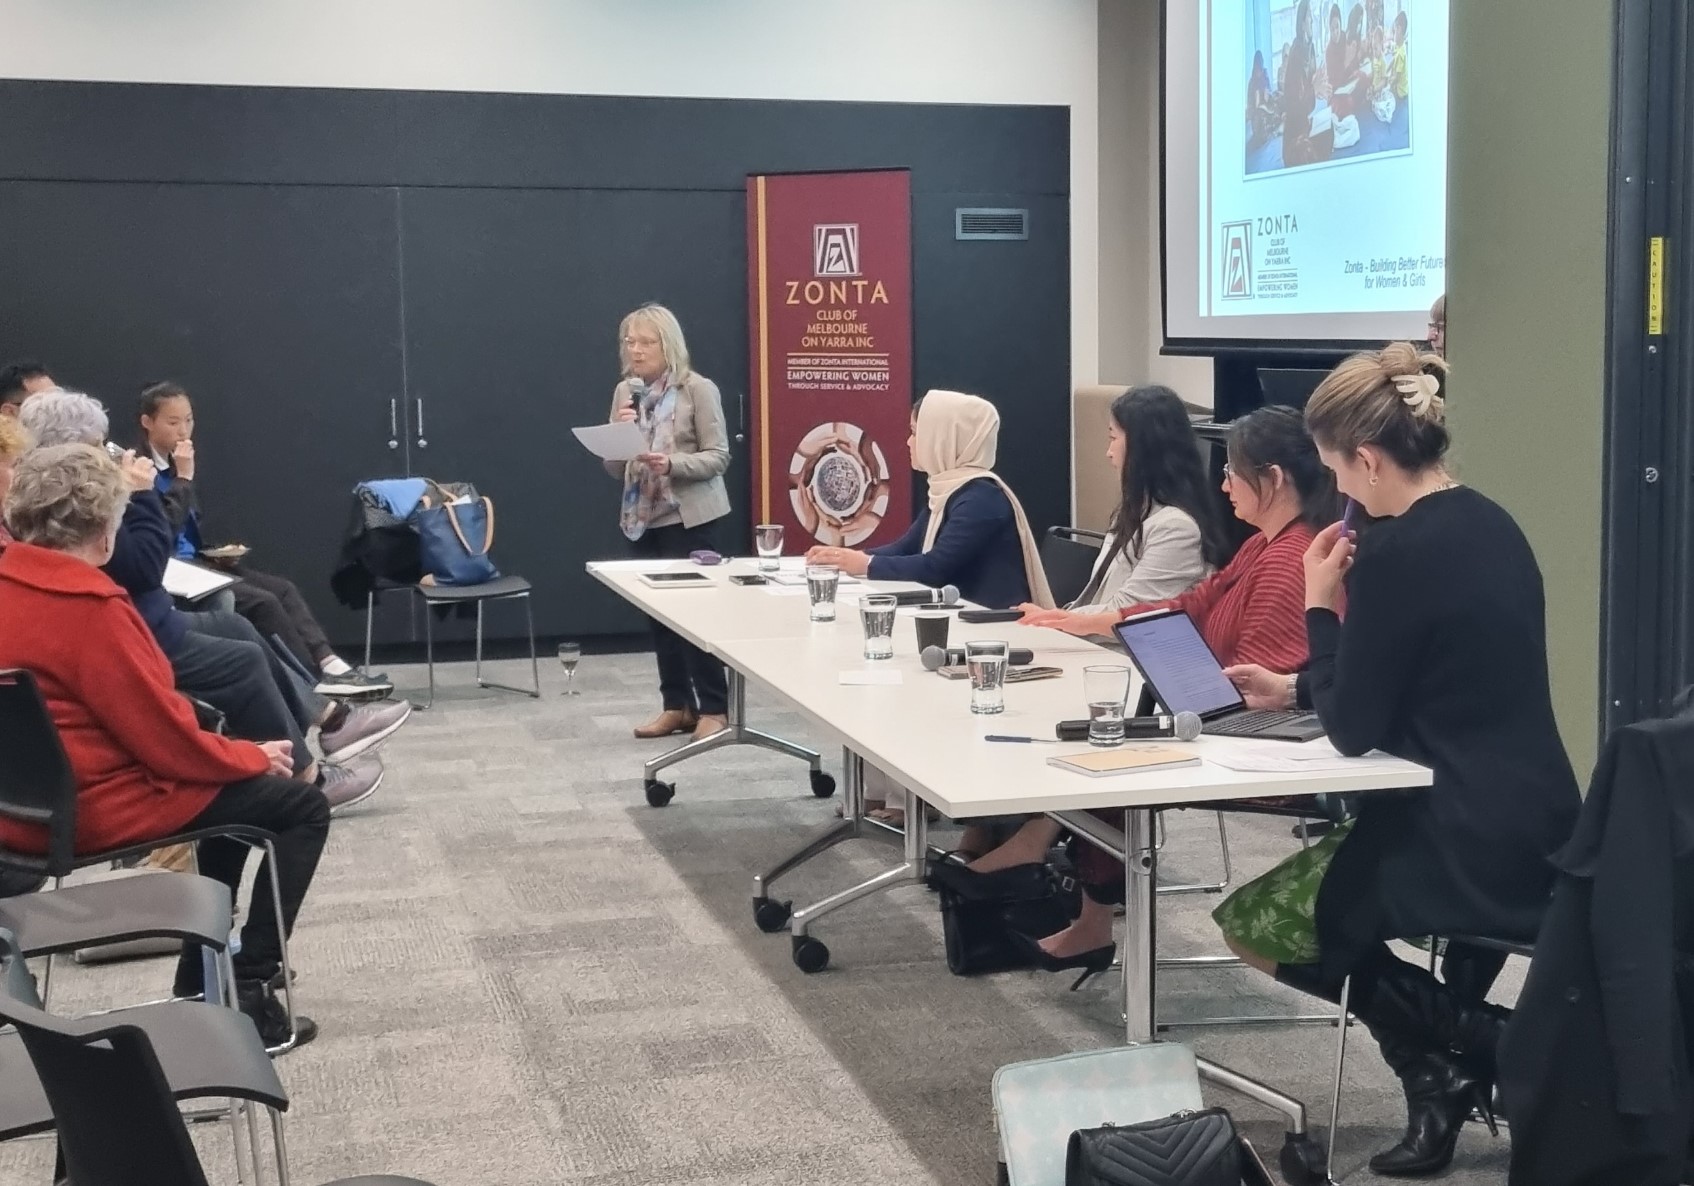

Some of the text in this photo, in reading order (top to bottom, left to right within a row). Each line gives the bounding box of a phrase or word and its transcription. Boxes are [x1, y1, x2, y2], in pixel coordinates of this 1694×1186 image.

[1257, 213, 1298, 236] ZONTA
[1344, 260, 1363, 274] Zonta
[1370, 258, 1397, 275] Building
[1398, 256, 1419, 271] Better
[1420, 255, 1444, 270] Future
[1364, 272, 1426, 289] for Women & Girls
[785, 280, 889, 305] ZONTA
[816, 309, 858, 321] CLUB OF
[807, 323, 868, 334] MELBOURNE
[801, 336, 874, 347] ON YARRA INC
[812, 358, 820, 366] OF
[821, 358, 840, 366] ZONTA
[840, 358, 889, 366] INTERNATIONAL
[787, 370, 890, 381] EMPOWERING WOMEN
[787, 382, 819, 390] THROUGH
[820, 382, 845, 390] SERVICE
[852, 383, 890, 391] ADVOCACY
